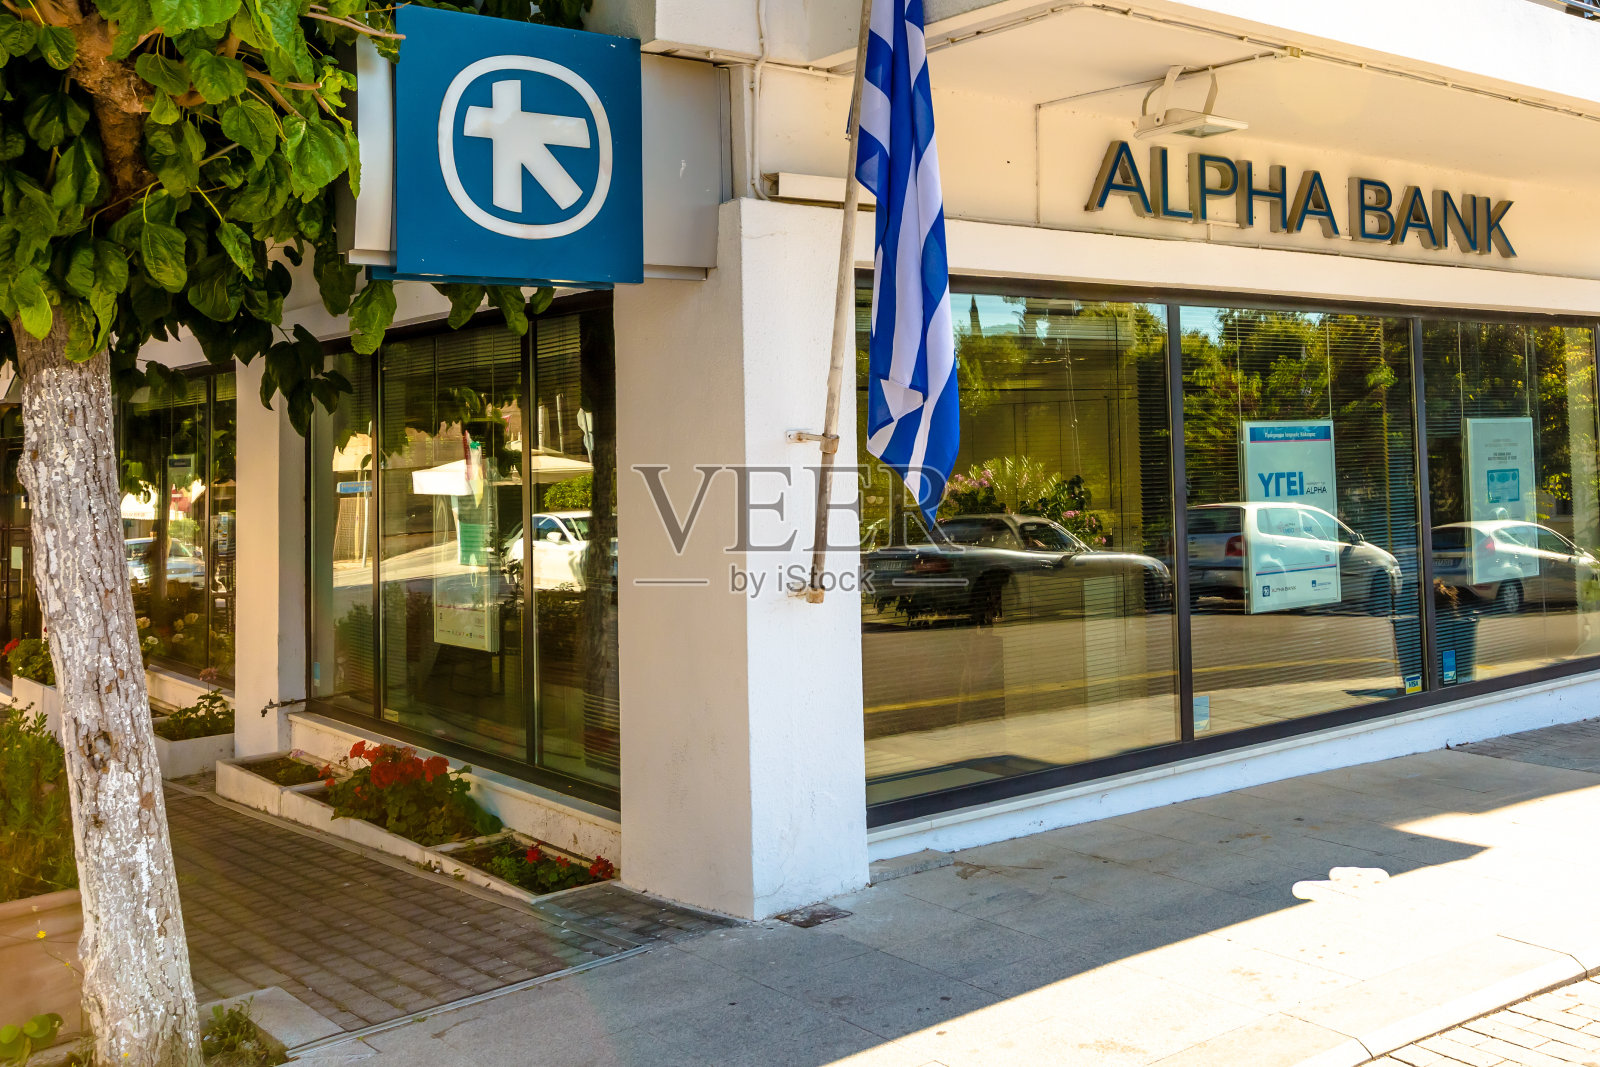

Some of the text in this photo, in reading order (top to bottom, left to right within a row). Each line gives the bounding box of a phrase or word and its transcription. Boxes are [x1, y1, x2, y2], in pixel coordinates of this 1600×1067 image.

[1084, 140, 1518, 258] ALPHA BANK
[1306, 486, 1327, 495] ALPHA
